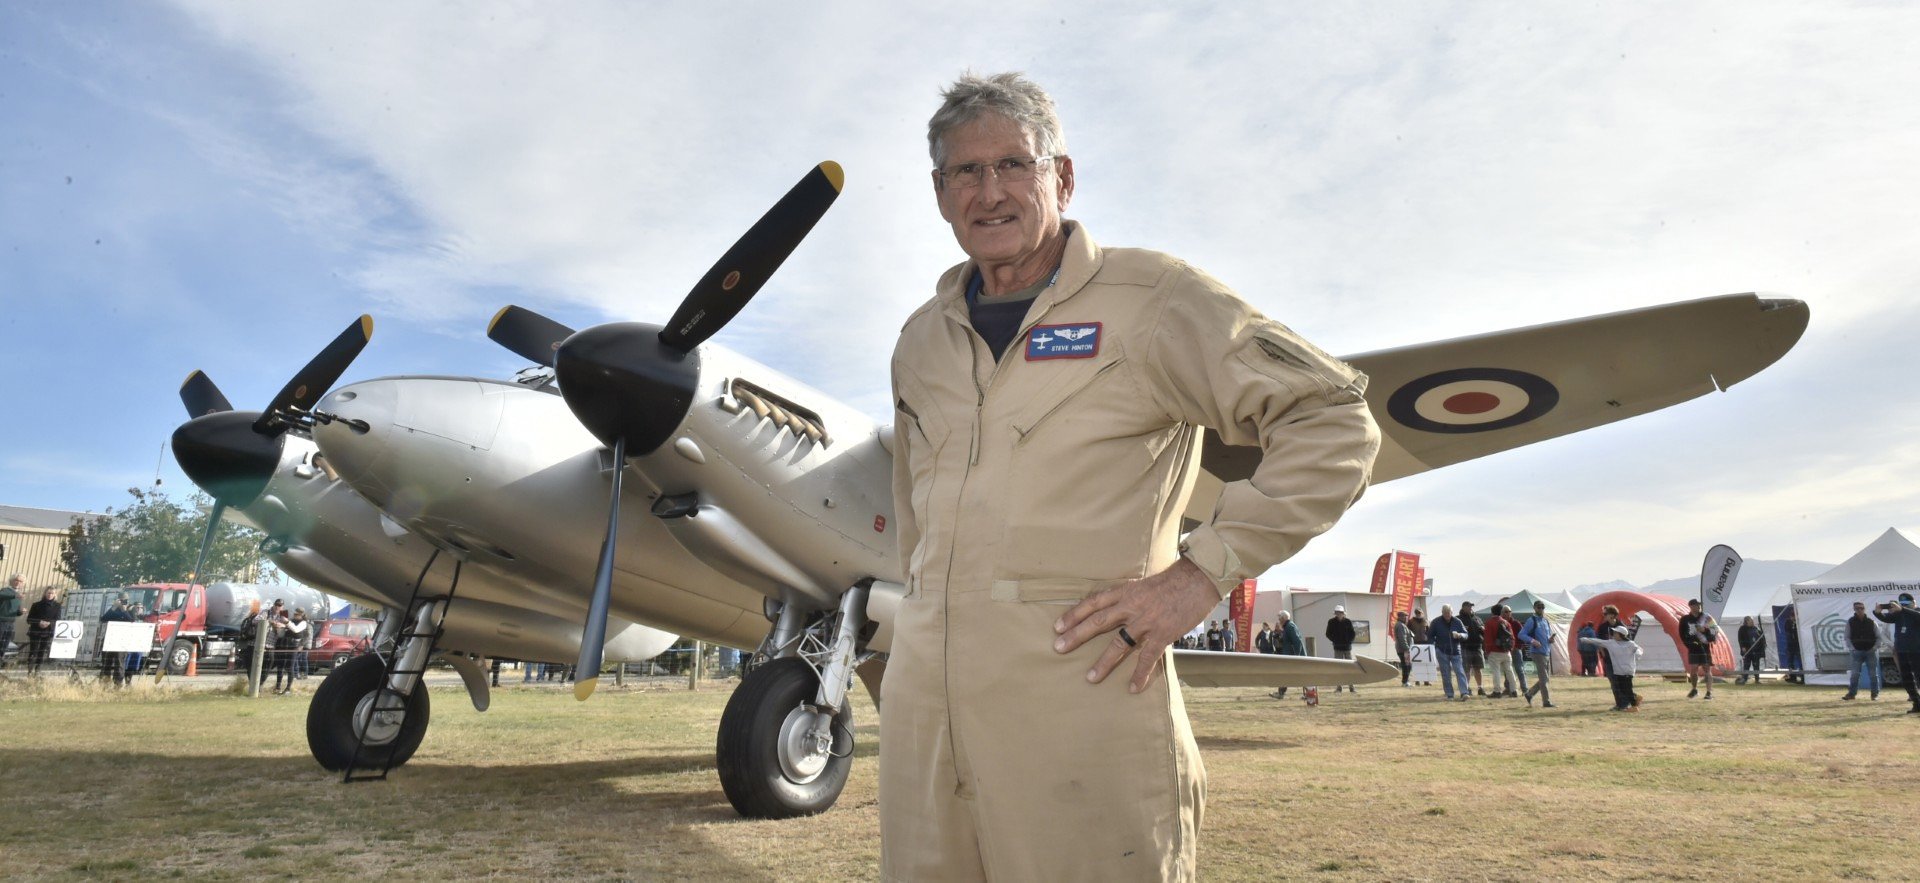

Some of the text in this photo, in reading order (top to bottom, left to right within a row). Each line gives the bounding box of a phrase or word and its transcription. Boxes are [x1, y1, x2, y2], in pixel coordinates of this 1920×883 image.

[1399, 556, 1415, 579] ART
[1712, 557, 1736, 595] hearing
[1796, 587, 1825, 595] www.
[55, 622, 82, 639] 20
[1411, 645, 1432, 662] 21
